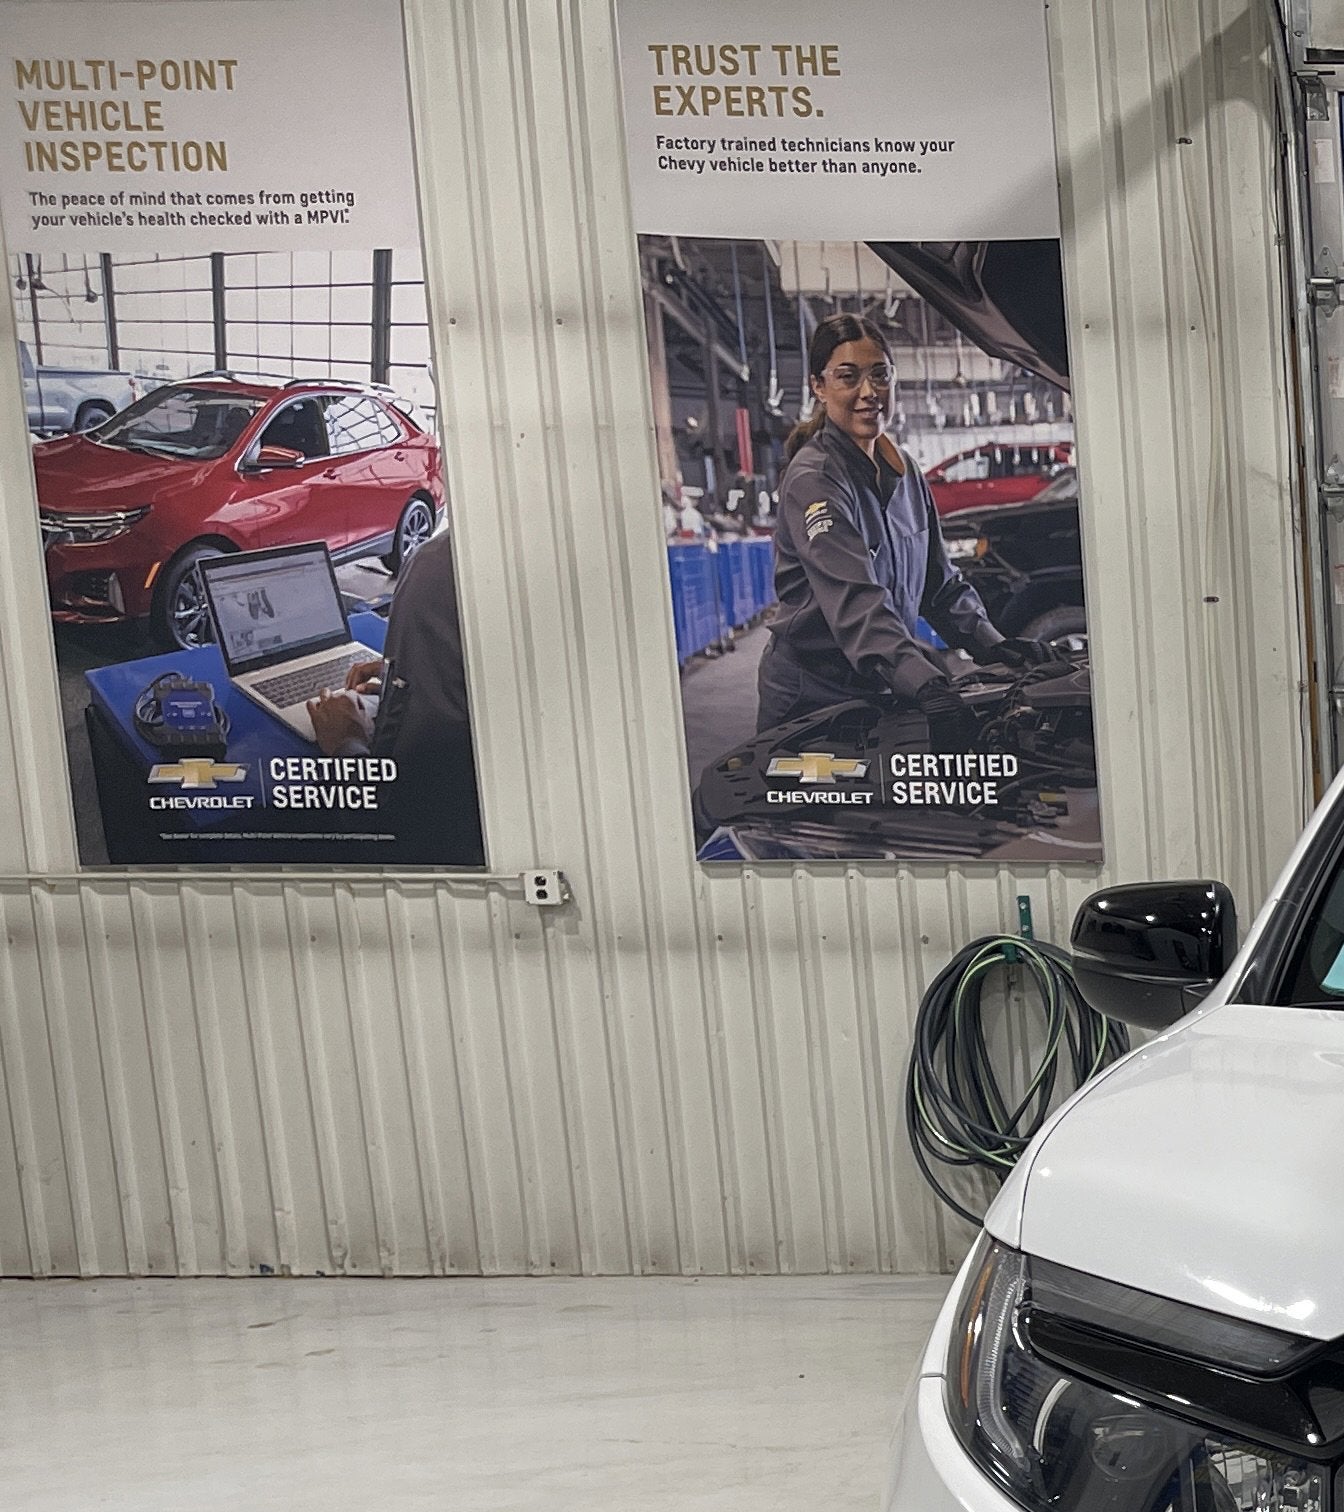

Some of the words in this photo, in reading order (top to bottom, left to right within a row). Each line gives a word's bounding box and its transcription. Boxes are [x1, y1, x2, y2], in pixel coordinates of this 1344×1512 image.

[648, 44, 761, 76] TRUST
[771, 45, 841, 76] THE
[15, 59, 238, 91] MULTI-POINT
[653, 85, 824, 118] EXPERTS.
[18, 100, 165, 132] VEHICLE
[24, 141, 228, 172] INSPECTION
[656, 135, 716, 154] Factory
[721, 137, 776, 151] trained
[781, 137, 870, 152] technicians
[874, 137, 916, 152] know
[919, 140, 956, 156] your
[658, 155, 705, 174] Chevy
[709, 157, 764, 172] vehicle
[769, 158, 818, 173] better
[821, 158, 857, 173] than
[862, 161, 922, 177] anyone.
[29, 191, 57, 206] The
[61, 194, 105, 210] peace
[109, 191, 124, 206] of
[129, 191, 166, 206] mind
[170, 191, 202, 206] that
[206, 192, 255, 205] comes
[259, 190, 296, 205] from
[300, 189, 355, 208] getting
[31, 214, 66, 231] your
[69, 211, 134, 226] vehicle's
[138, 211, 186, 226] health
[190, 210, 252, 226] checked
[256, 210, 290, 225] with
[294, 213, 303, 224] a
[270, 758, 398, 782] CERTIFIED
[890, 754, 1018, 777] CERTIFIED
[150, 796, 255, 810] CHEVROLET
[272, 785, 379, 810] SERVICE
[766, 791, 874, 805] CHEVROLET
[892, 781, 998, 805] SERVICE
